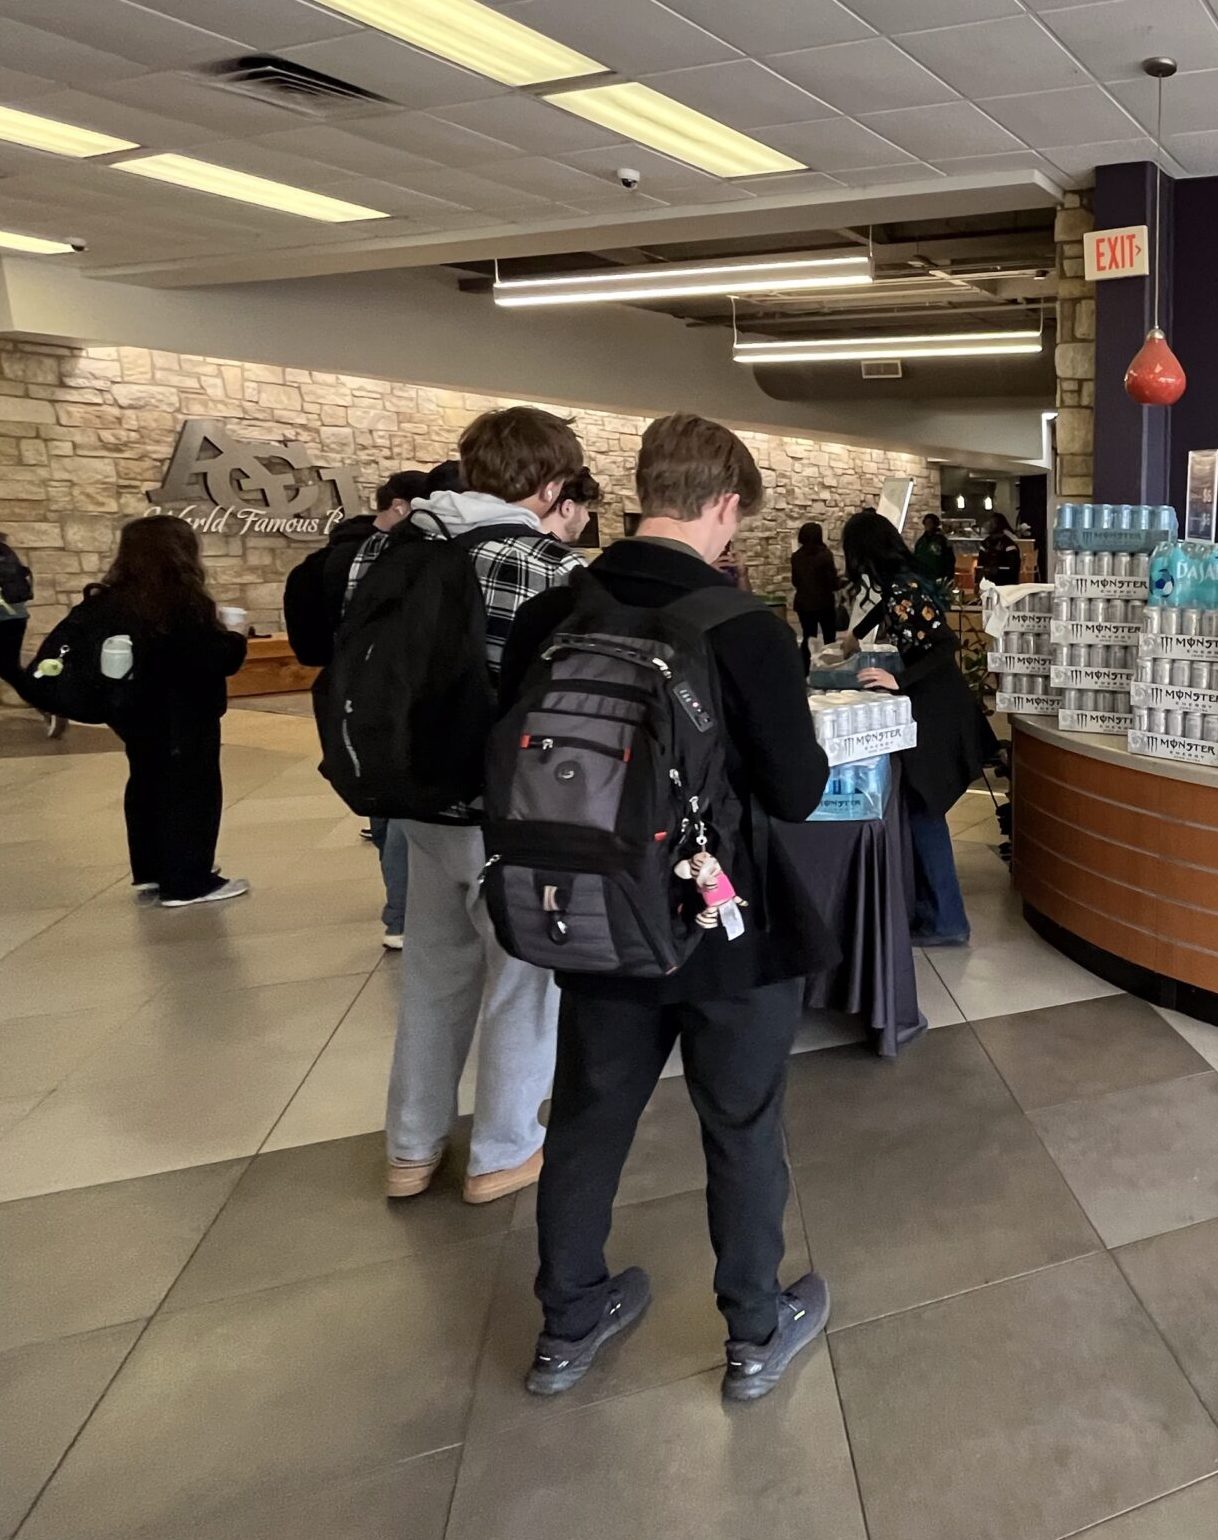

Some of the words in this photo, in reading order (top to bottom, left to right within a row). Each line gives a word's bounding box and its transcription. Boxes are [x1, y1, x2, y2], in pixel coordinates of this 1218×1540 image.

[1095, 233, 1136, 272] EXIT
[237, 508, 319, 535] Famous
[1090, 578, 1148, 589] MONSTER
[1012, 613, 1052, 623] MONST
[1085, 623, 1142, 634] MONSTER
[1017, 656, 1052, 666] MONST
[1084, 670, 1135, 681] MONSTE
[1026, 696, 1060, 707] MONST
[1090, 714, 1133, 725] MONST
[856, 728, 902, 745] MONSTER
[1160, 738, 1216, 756] MONSTER
[821, 800, 861, 808] ONSTER
